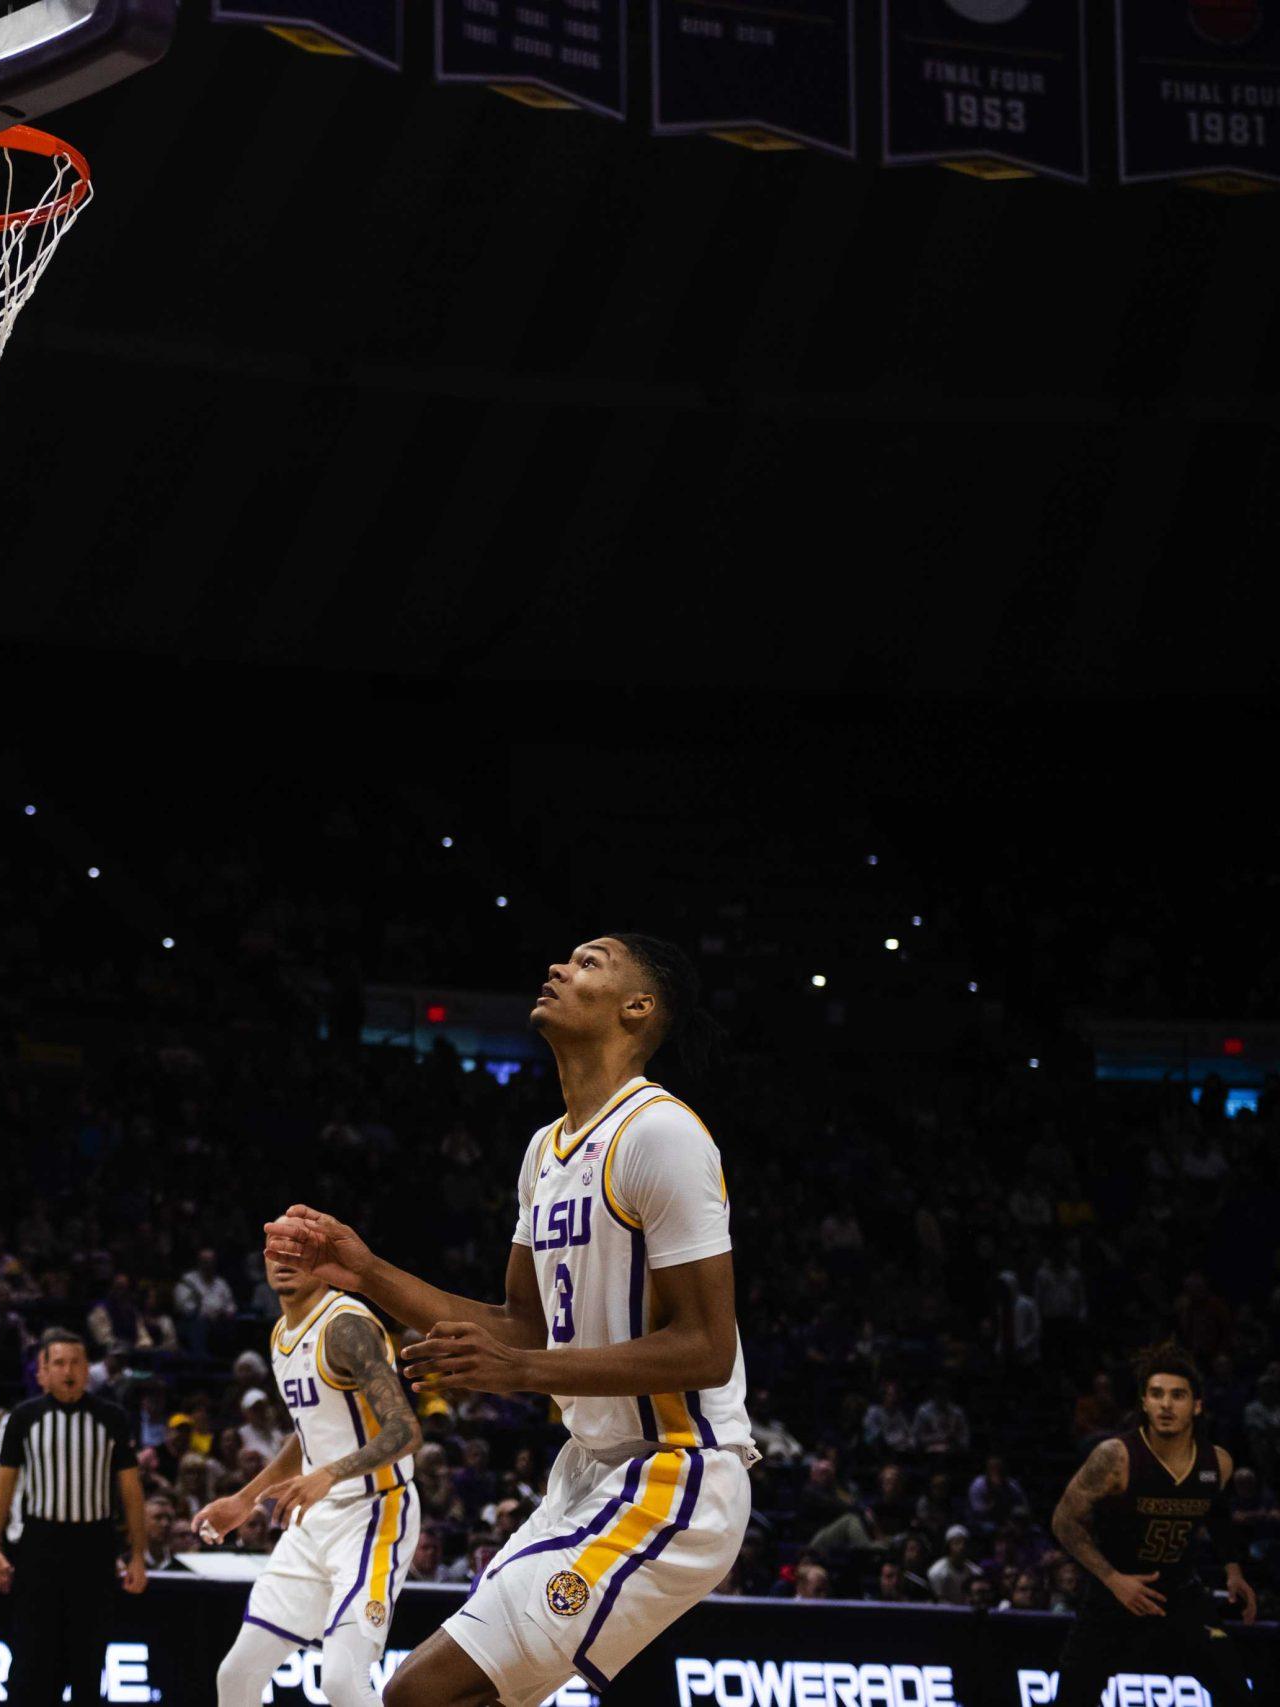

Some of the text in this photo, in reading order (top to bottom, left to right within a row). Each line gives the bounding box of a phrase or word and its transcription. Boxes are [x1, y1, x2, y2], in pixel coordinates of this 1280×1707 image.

[922, 58, 1047, 95] FINAL FOUR
[1159, 76, 1223, 105] FINAL
[943, 89, 1027, 134] 1953
[1186, 109, 1267, 148] 1981
[532, 1196, 593, 1252] LSU
[552, 1263, 575, 1343] 3
[1136, 1517, 1193, 1565] 55
